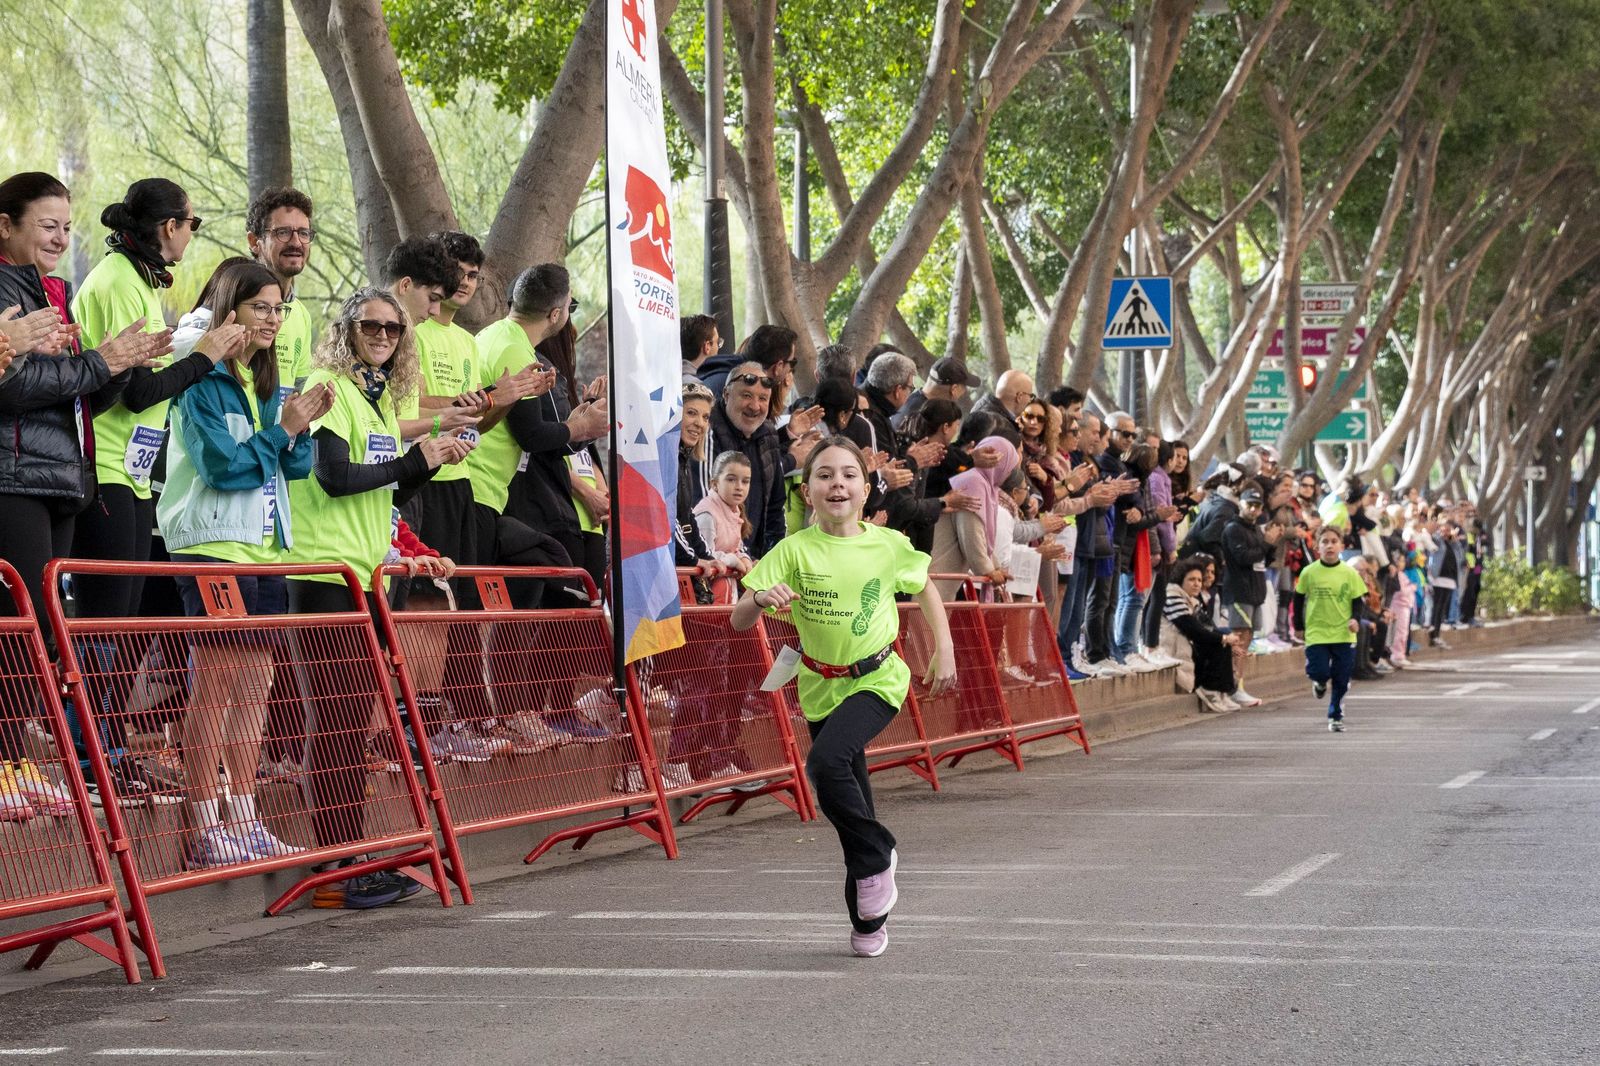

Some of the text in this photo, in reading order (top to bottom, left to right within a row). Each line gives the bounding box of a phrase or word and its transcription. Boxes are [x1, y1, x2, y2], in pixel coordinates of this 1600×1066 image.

[132, 448, 159, 469] 38
[815, 608, 823, 616] el
[824, 609, 854, 617] cáncer
